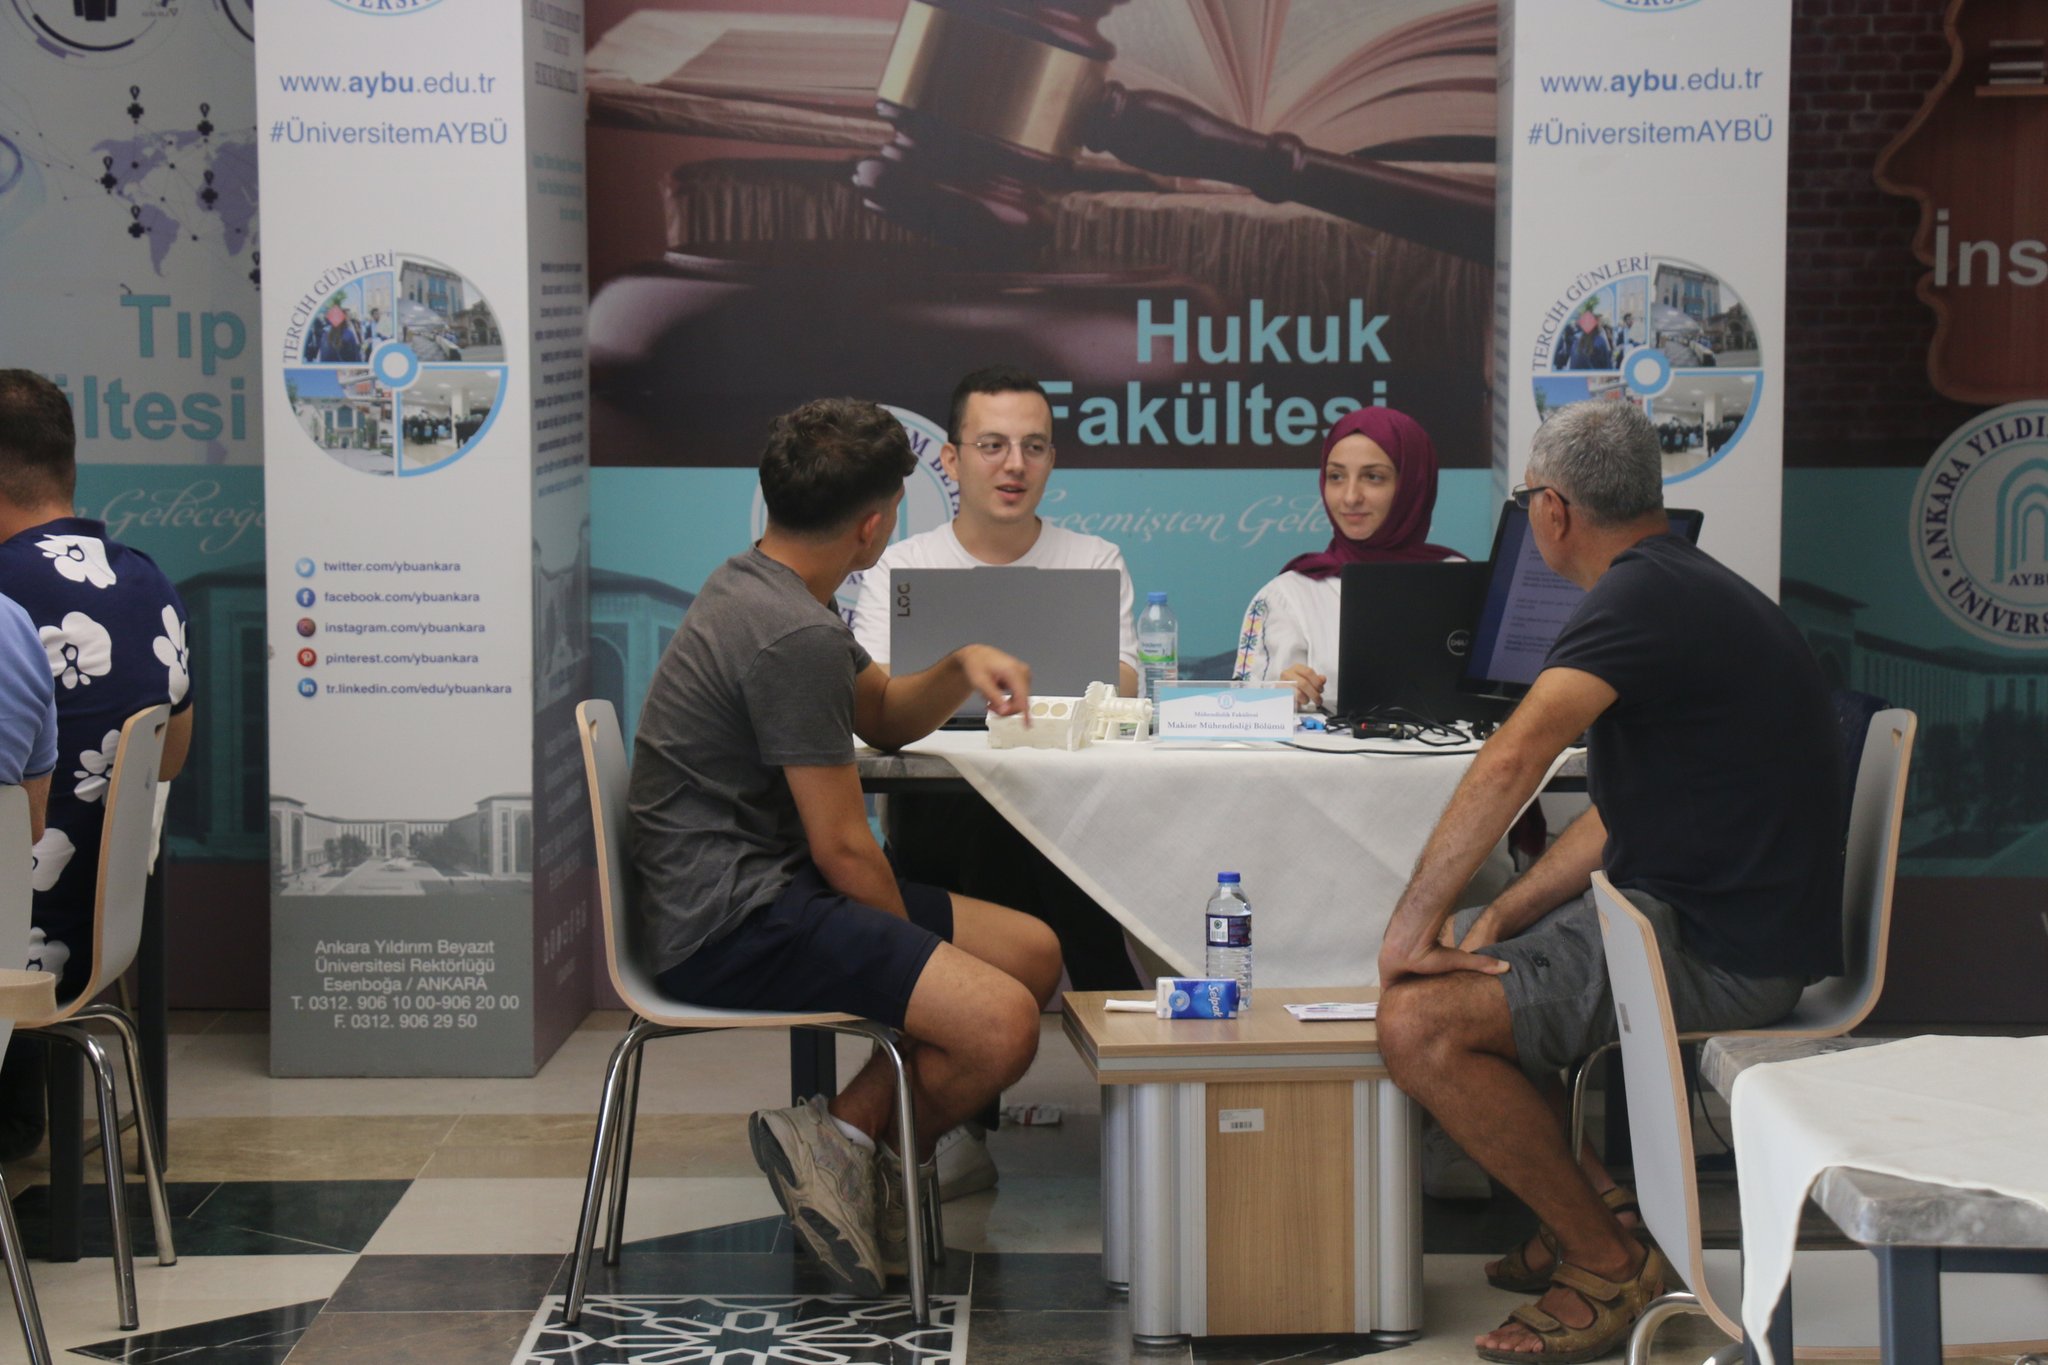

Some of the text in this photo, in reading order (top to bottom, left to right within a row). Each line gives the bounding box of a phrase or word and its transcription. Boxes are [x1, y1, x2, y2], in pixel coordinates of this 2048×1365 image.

[280, 71, 496, 98] www.aybu.edu.tr
[1540, 67, 1764, 98] www.aybu.edu.tr
[270, 116, 508, 145] #ÜniversitemAYBÜ
[1528, 113, 1773, 145] #ÜniversitemAYBÜ
[282, 249, 394, 363] TERCİH GÜNLERİ
[1531, 251, 1649, 371] TERCİH GÜNLERİ
[120, 294, 247, 376] Tıp
[1137, 298, 1391, 363] Hukuk
[1925, 415, 2048, 561] ANKARA YILDI
[324, 561, 461, 573] twitter.com/ybuankara
[2008, 573, 2048, 587] AYB
[324, 591, 480, 604] facebook.com/ybuankara
[325, 622, 486, 635] instagram.com/ybuankara
[325, 653, 479, 666] pinterest.com/ybuankara
[326, 684, 512, 696] tr.linkedin.com/edu/ybuankara
[1168, 721, 1286, 731] Makine Mühendisliği Bölümü
[315, 940, 495, 957] Ankara Yıldırım Beyazıt
[315, 956, 495, 976] Üniversitesi Rektörlüğü
[323, 977, 402, 994] Esenboğa
[416, 977, 488, 991] ANKARA
[291, 995, 520, 1011] T. 0312. 906 10 00-906 20 00
[1208, 984, 1224, 1018] Selpak
[334, 1014, 478, 1029] F. 0312. 906 29 50
